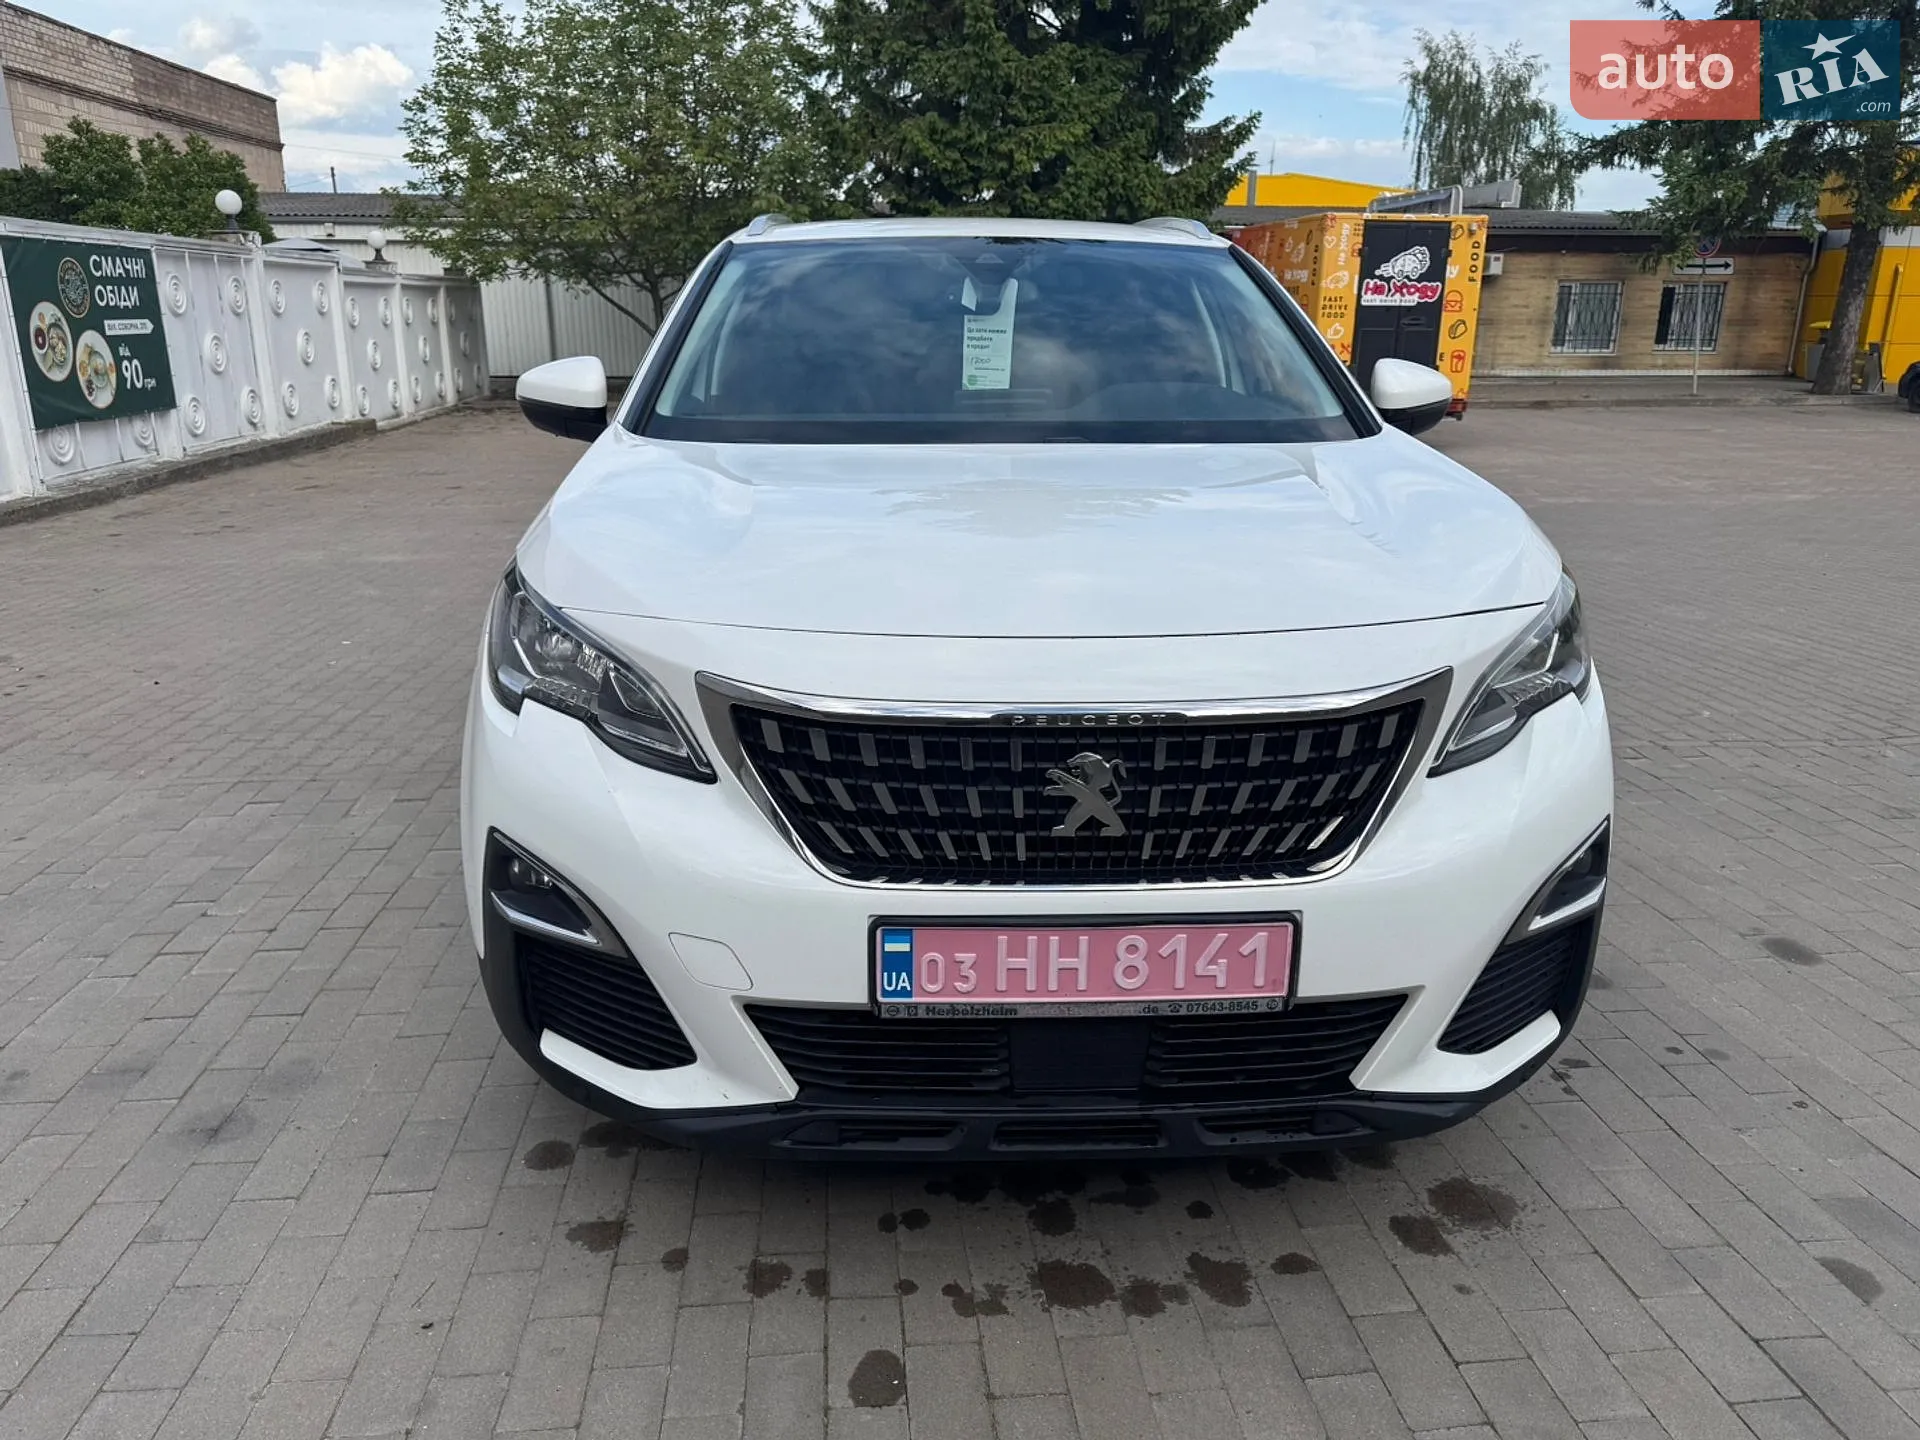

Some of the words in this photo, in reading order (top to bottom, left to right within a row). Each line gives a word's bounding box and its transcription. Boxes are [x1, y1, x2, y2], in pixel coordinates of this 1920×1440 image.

[90, 255, 146, 278] СМАЧНІ
[1469, 241, 1481, 282] FOOD
[95, 285, 140, 309] ОБІДИ
[122, 359, 143, 389] 90
[1011, 714, 1166, 726] PEUGEOT
[883, 972, 911, 991] UA
[920, 952, 978, 993] 03
[996, 935, 1089, 991] HH
[1113, 932, 1269, 991] 8141
[925, 1004, 1018, 1017] Herbolzheim
[1186, 1002, 1258, 1014] 07643-8545
